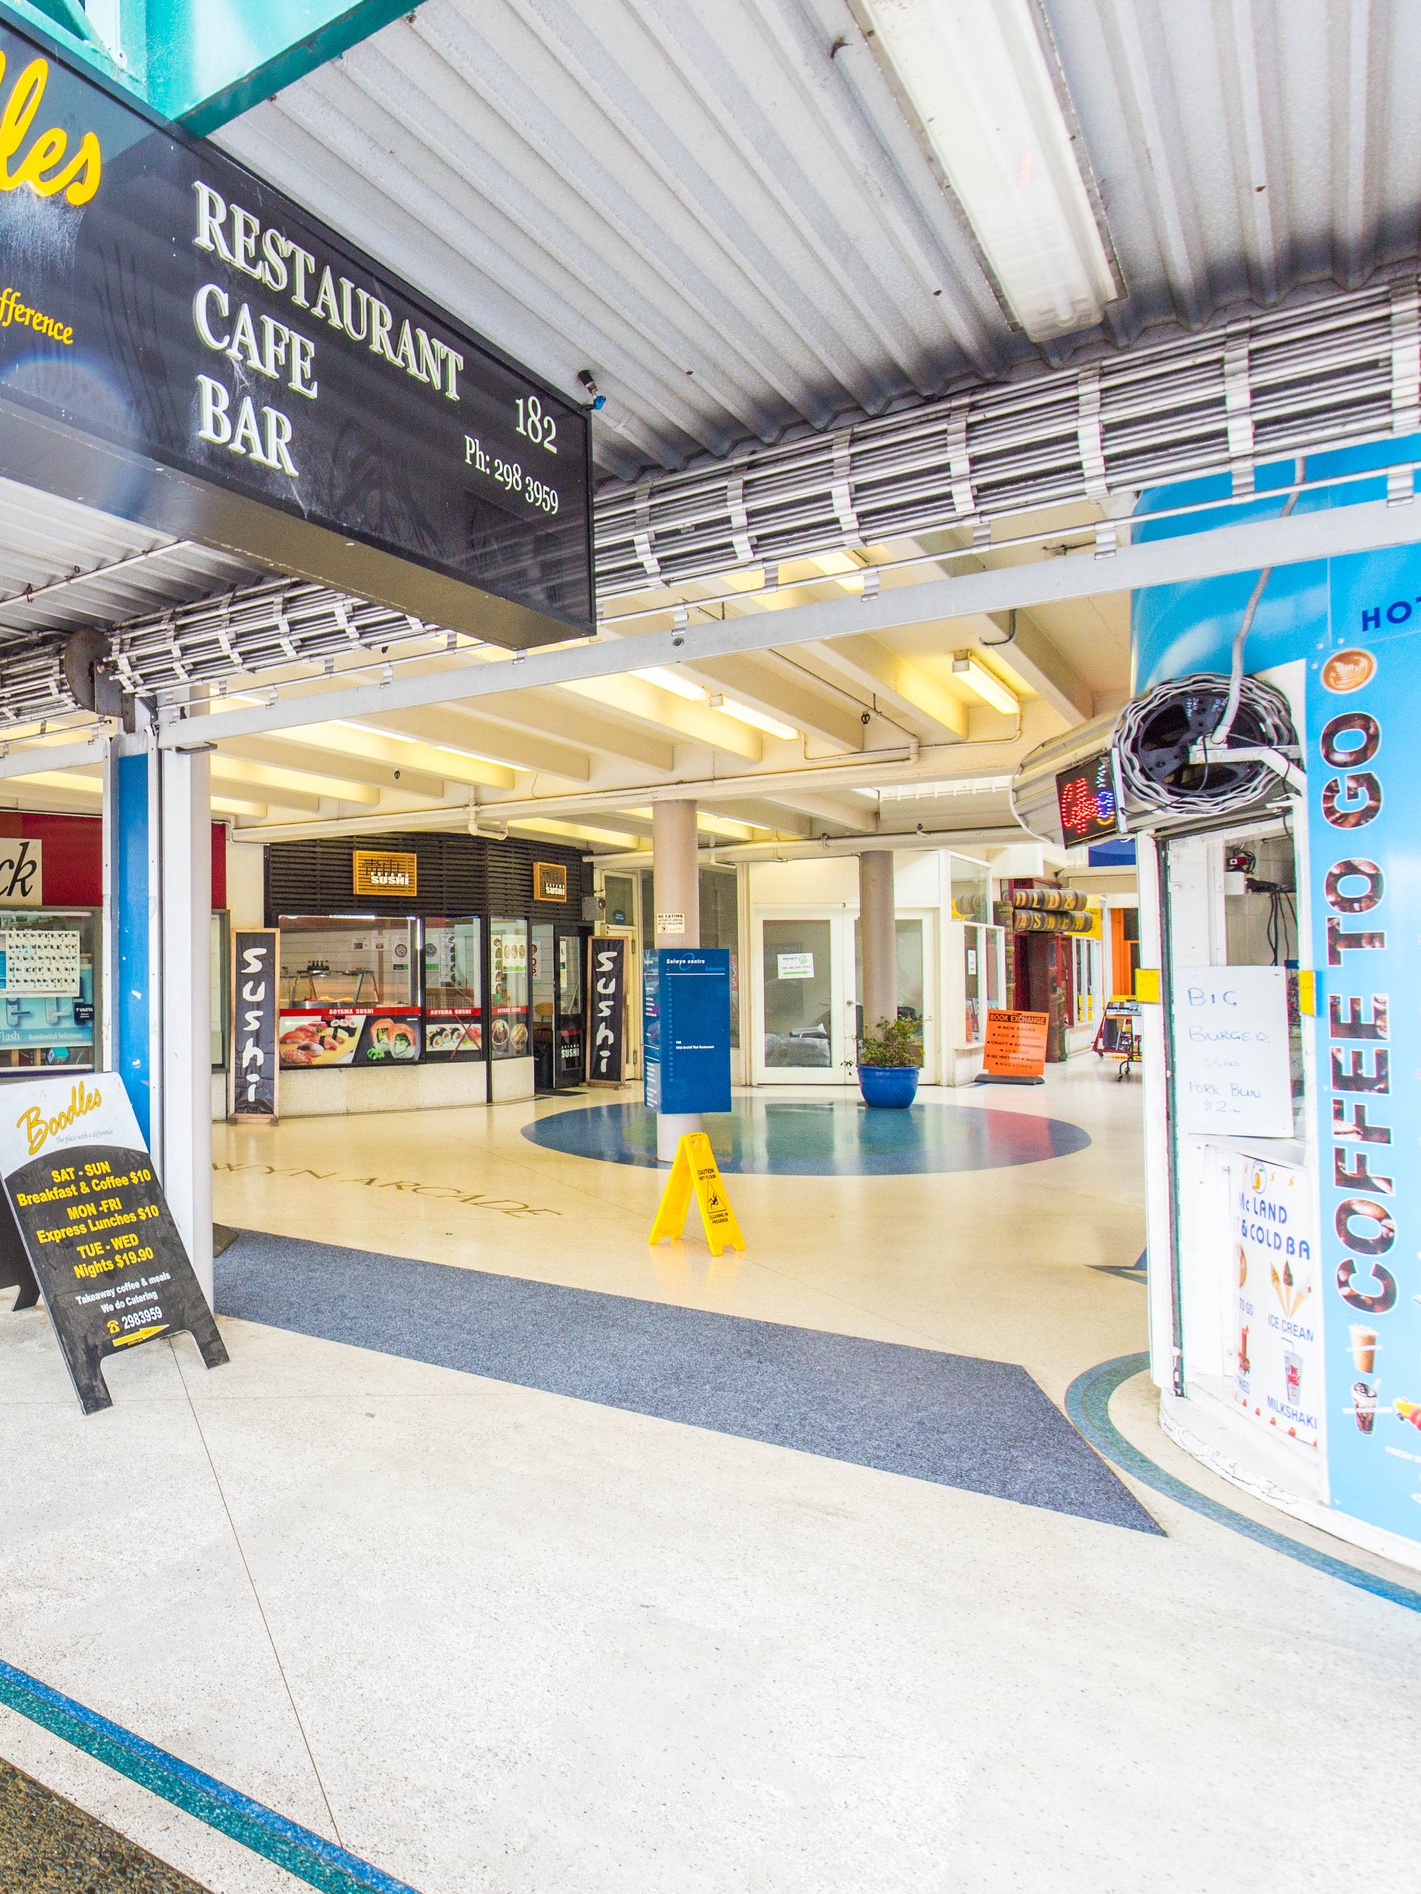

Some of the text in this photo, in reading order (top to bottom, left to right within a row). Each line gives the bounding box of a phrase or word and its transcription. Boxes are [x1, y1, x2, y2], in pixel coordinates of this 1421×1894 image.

[192, 180, 463, 401] RESTAURANT
[193, 283, 318, 399] CAFE
[196, 374, 299, 476] BAR
[515, 395, 558, 454] 182
[464, 435, 559, 515] Ph: 298 3959
[1362, 596, 1421, 632] HO
[1320, 711, 1383, 829] GO
[1325, 858, 1387, 967] TO
[1188, 987, 1237, 1007] BIG
[990, 1014, 1045, 1025] BOOK EXCHANGE
[1188, 1025, 1270, 1043] BURGER
[561, 1048, 580, 1058] SUSHI
[16, 1080, 102, 1155] Boodles
[1328, 992, 1400, 1315] COFFEE
[16, 1169, 152, 1207] Breakfast & Coffee $10
[51, 1167, 76, 1183] SAT
[84, 1161, 111, 1177] SUN
[697, 1168, 714, 1176] CAUTION
[67, 1203, 97, 1220] MON
[339, 1177, 563, 1219] ARCADE
[1253, 1196, 1288, 1225] LAND
[36, 1205, 159, 1244] Express Lunches $10
[1241, 1218, 1248, 1239] &
[1249, 1223, 1283, 1251] COLD
[76, 1242, 104, 1259] TUE
[110, 1233, 139, 1251] WED
[73, 1247, 154, 1279] Nights $19.90
[75, 1272, 171, 1305] Takeaway coffee & meals
[100, 1291, 158, 1314] We do Catering
[121, 1306, 163, 1330] 2983959
[1267, 1313, 1280, 1330] ICE
